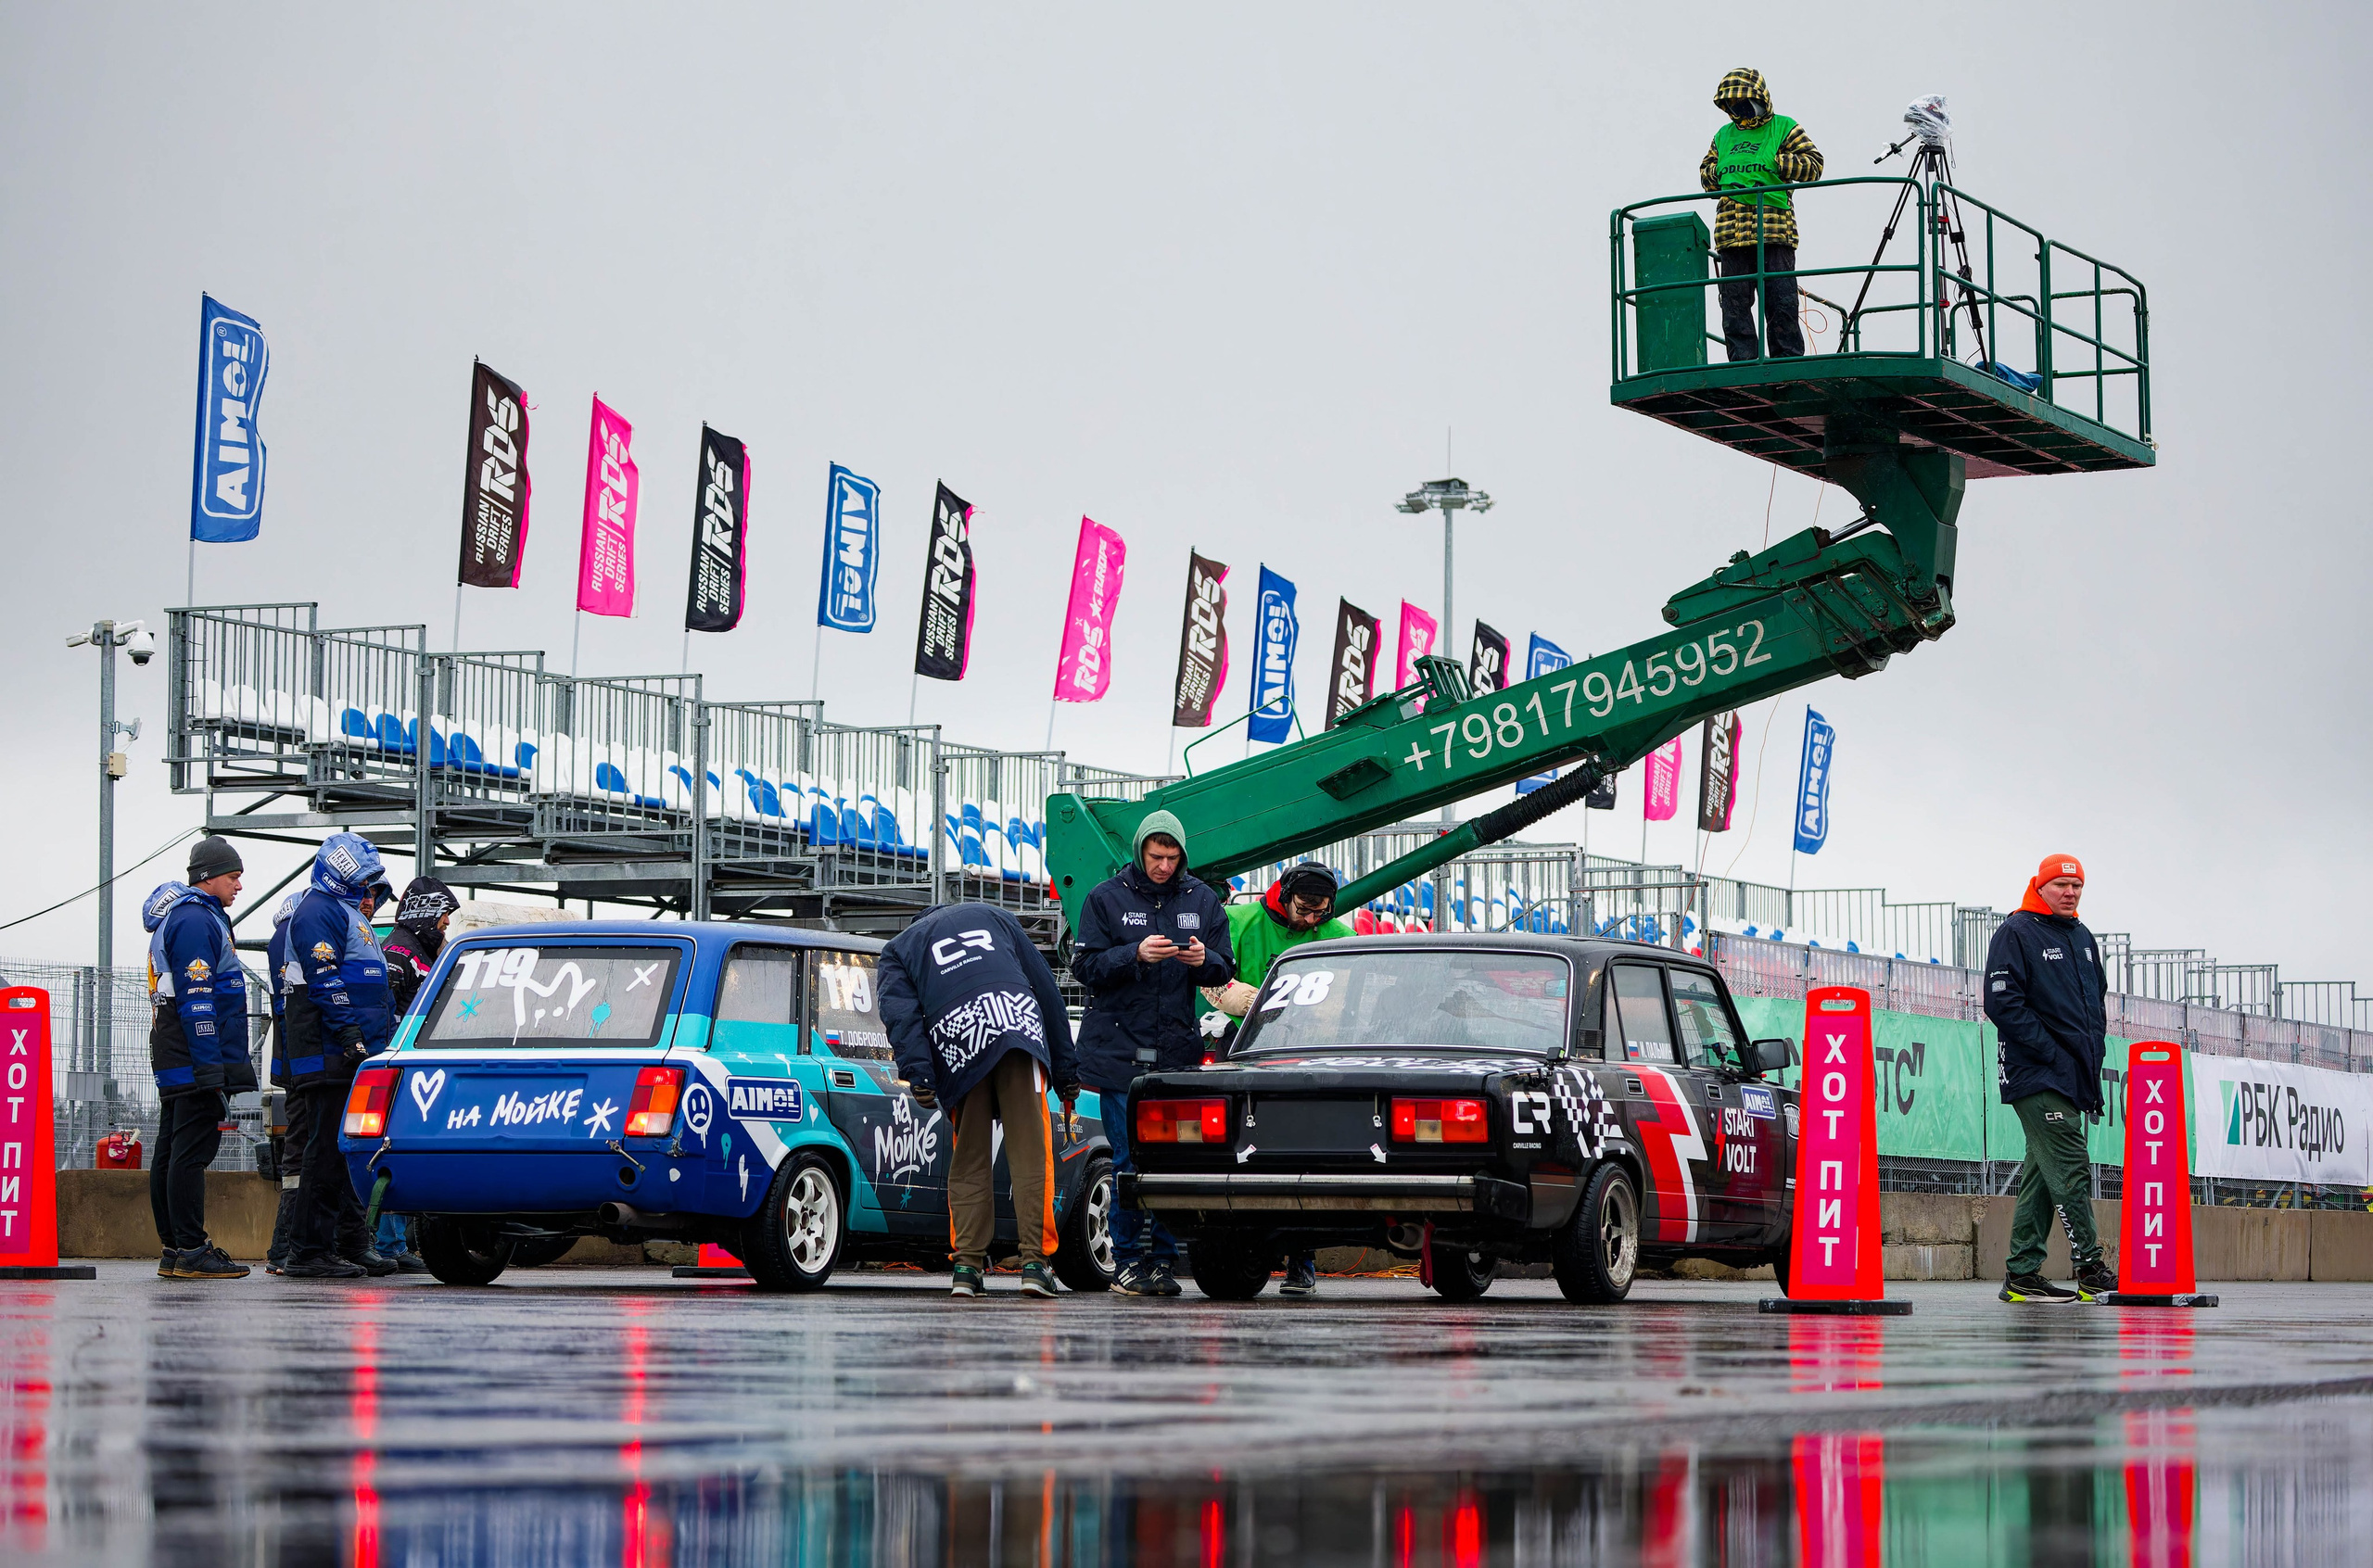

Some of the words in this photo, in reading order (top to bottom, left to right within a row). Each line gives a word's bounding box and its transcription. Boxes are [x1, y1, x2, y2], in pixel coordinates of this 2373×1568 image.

[479, 384, 519, 502] RDS
[598, 417, 628, 530] RDS
[701, 444, 733, 559] RDS
[475, 499, 490, 564] RUSSIAN
[486, 506, 501, 551] DRIFT
[496, 513, 514, 564] SERIES
[931, 499, 966, 605] RDS
[591, 527, 608, 593] RUSSIAN
[604, 537, 618, 580] DRIFT
[615, 543, 628, 593] SERIES
[696, 550, 711, 613] RUSSIAN
[707, 561, 721, 602] DRIFT
[718, 567, 732, 615] SERIES
[1188, 565, 1220, 663] RDS
[924, 599, 939, 658] RUSSIAN
[934, 609, 948, 646] DRIFT
[945, 614, 958, 661] SERIES
[1073, 620, 1104, 694] RDS
[1338, 613, 1371, 707] RDS
[1474, 636, 1499, 699] DS
[1191, 670, 1212, 712] SERIES
[1403, 619, 1772, 771] +79817945952
[1652, 761, 1661, 807] RUSSIAN
[1658, 767, 1667, 797] DRIFT
[1664, 771, 1673, 807] SERIES
[454, 947, 539, 991] 119
[932, 929, 996, 966] CR
[962, 955, 983, 965] RACING
[819, 964, 872, 1013] 119
[1261, 970, 1335, 1012] 28
[8, 1029, 29, 1124] ХОТ
[730, 1086, 799, 1113] AIMOL
[1822, 1034, 1846, 1140] ХОТ
[1512, 1092, 1551, 1134] CR
[1745, 1093, 1773, 1112] AIMOL
[2045, 1112, 2064, 1120] CR
[2144, 1080, 2164, 1165] ХОТ
[2240, 1081, 2282, 1148] РБК
[2287, 1086, 2345, 1162] Радио
[1725, 1143, 1757, 1173] VOLT
[0, 1142, 22, 1237] ПИТ
[1818, 1160, 1843, 1267] ПИТ
[2144, 1182, 2164, 1268] ПИТ
